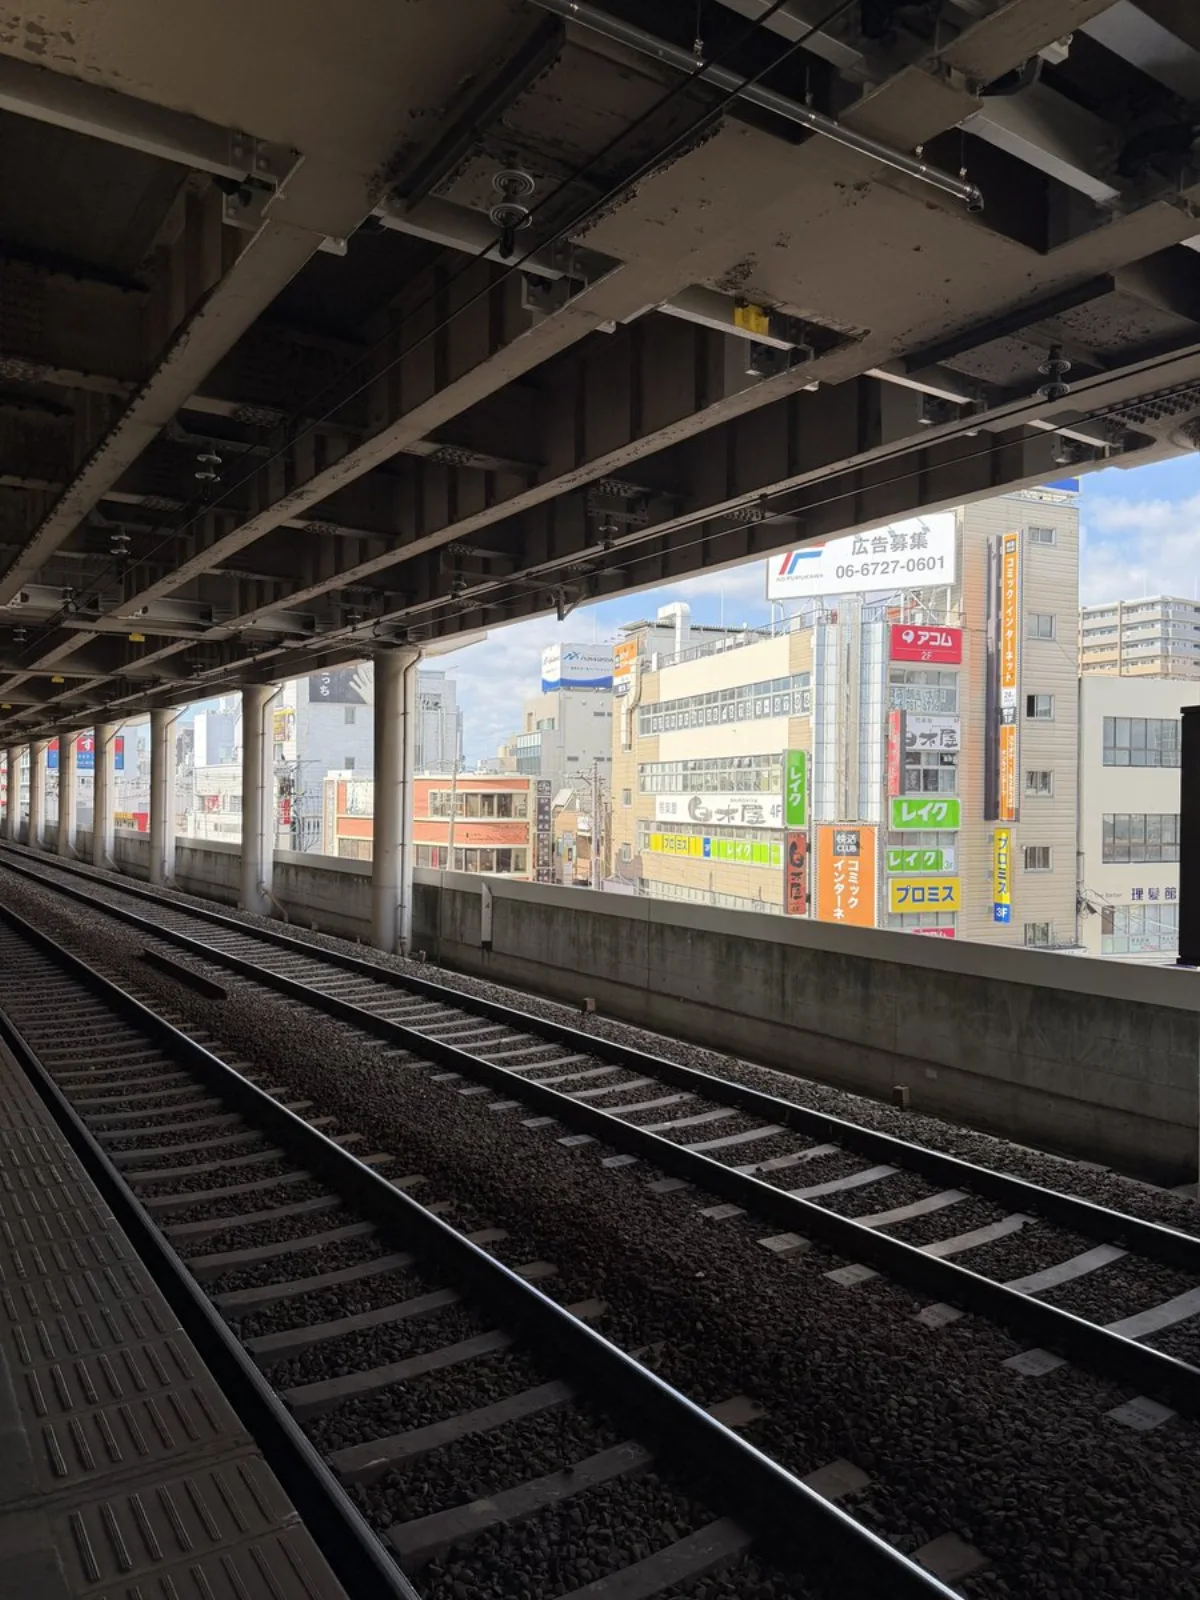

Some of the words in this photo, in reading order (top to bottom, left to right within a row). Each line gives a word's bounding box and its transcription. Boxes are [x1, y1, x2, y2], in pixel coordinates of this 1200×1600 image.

[852, 532, 928, 556] 広告募集
[835, 555, 945, 579] 06-6727-0601
[917, 631, 953, 647] アコム
[921, 651, 933, 660] 2F
[789, 767, 802, 807] レイク
[902, 802, 948, 822] レイク
[889, 851, 937, 867] レイク
[998, 836, 1009, 894] プロミス
[833, 860, 846, 919] インターネ
[847, 860, 861, 909] コミック
[896, 885, 956, 904] プロミス
[996, 908, 1008, 917] 3F
